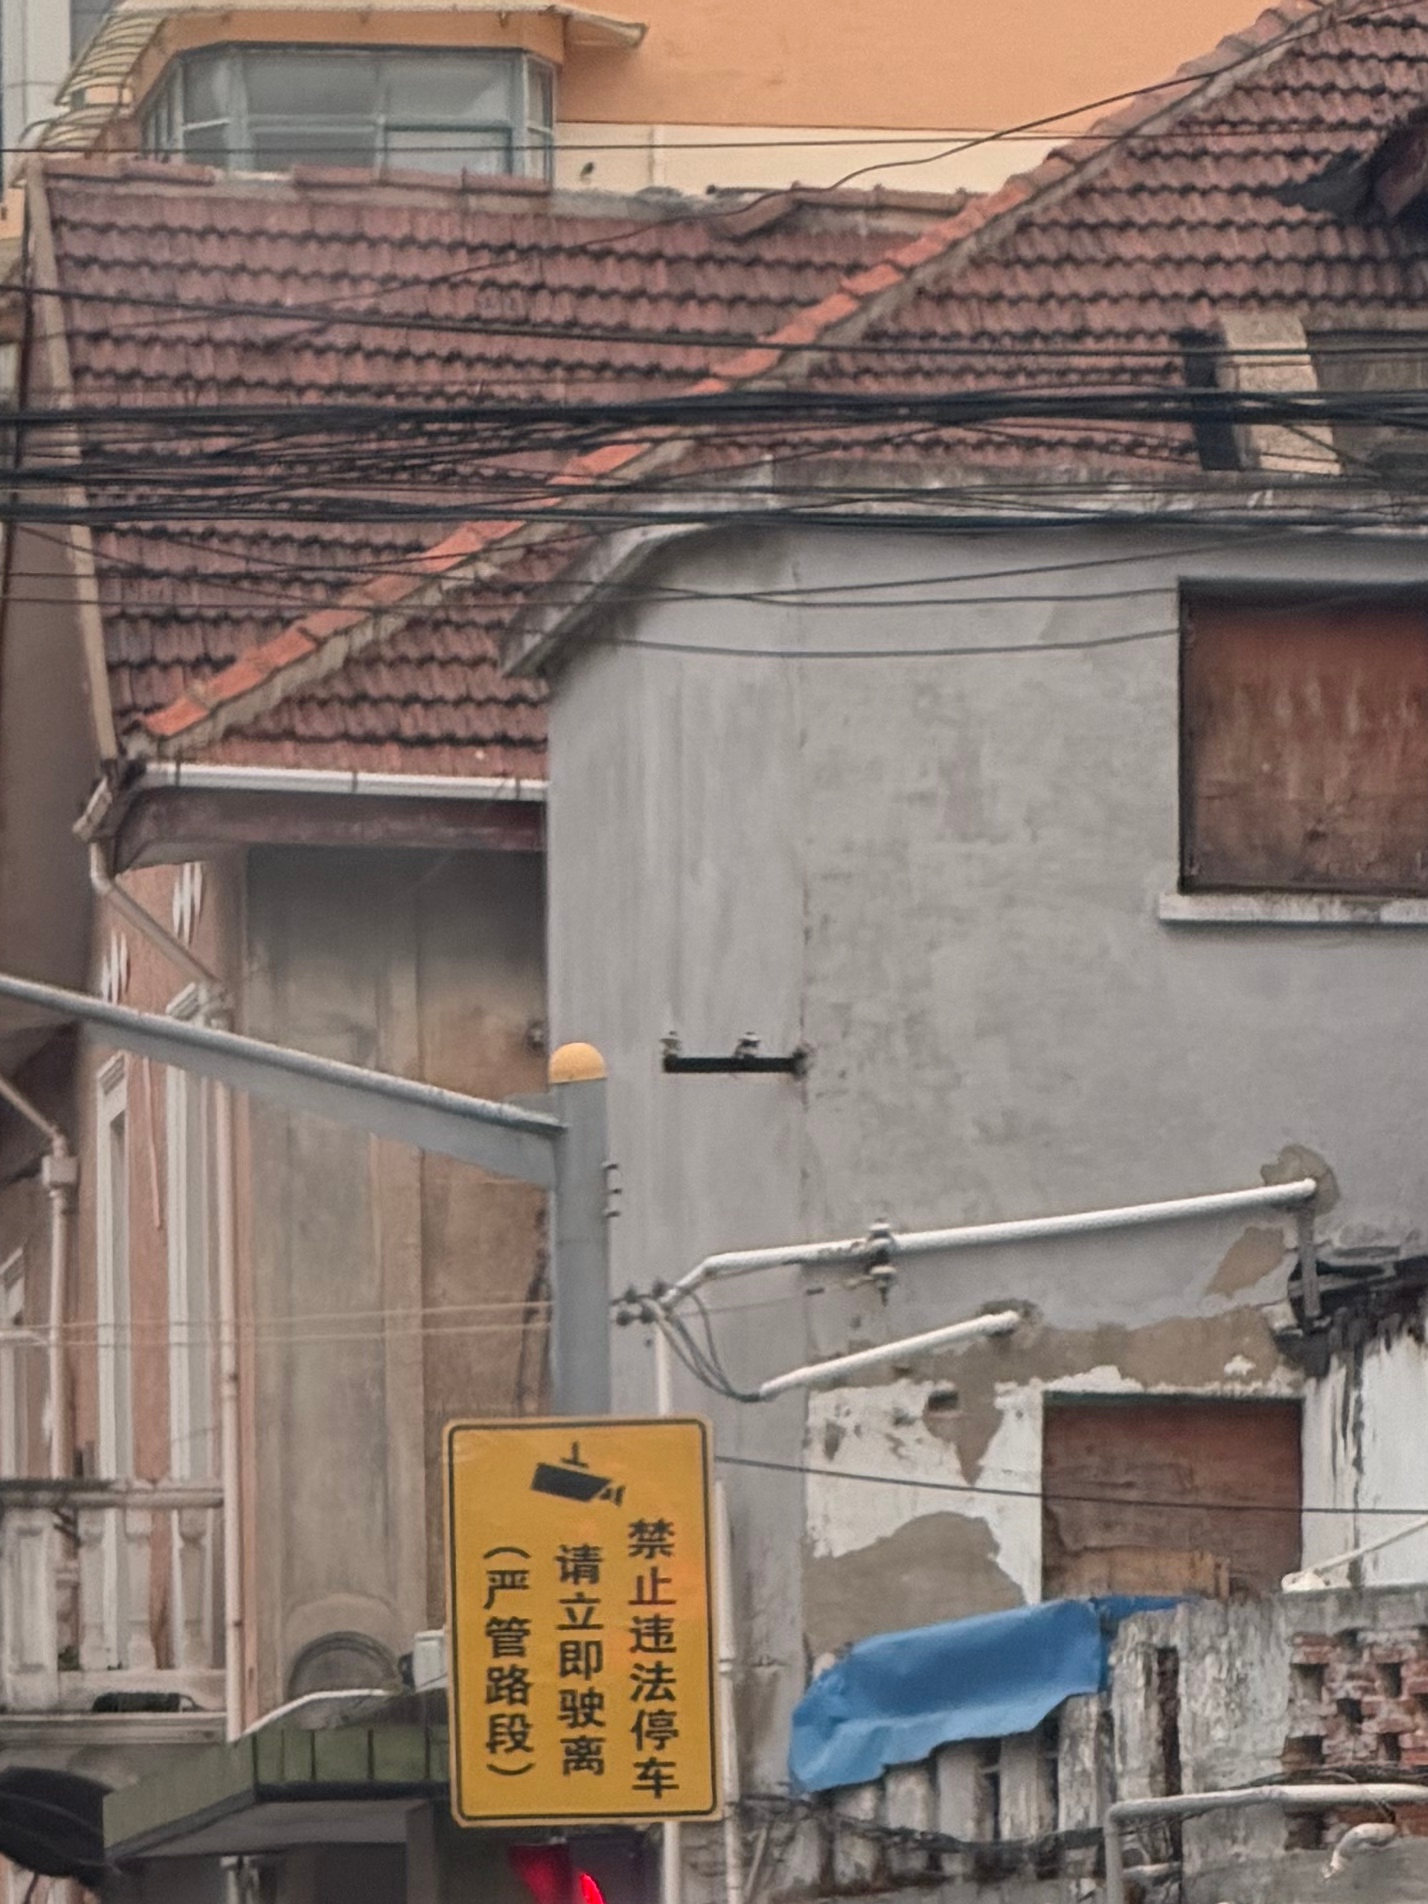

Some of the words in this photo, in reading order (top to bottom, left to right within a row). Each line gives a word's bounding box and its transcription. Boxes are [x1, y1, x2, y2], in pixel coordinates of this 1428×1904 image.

[483, 1545, 535, 1777] （严管路段）
[555, 1543, 606, 1777] 请立即驶离
[628, 1517, 680, 1799] 禁止违法停车
